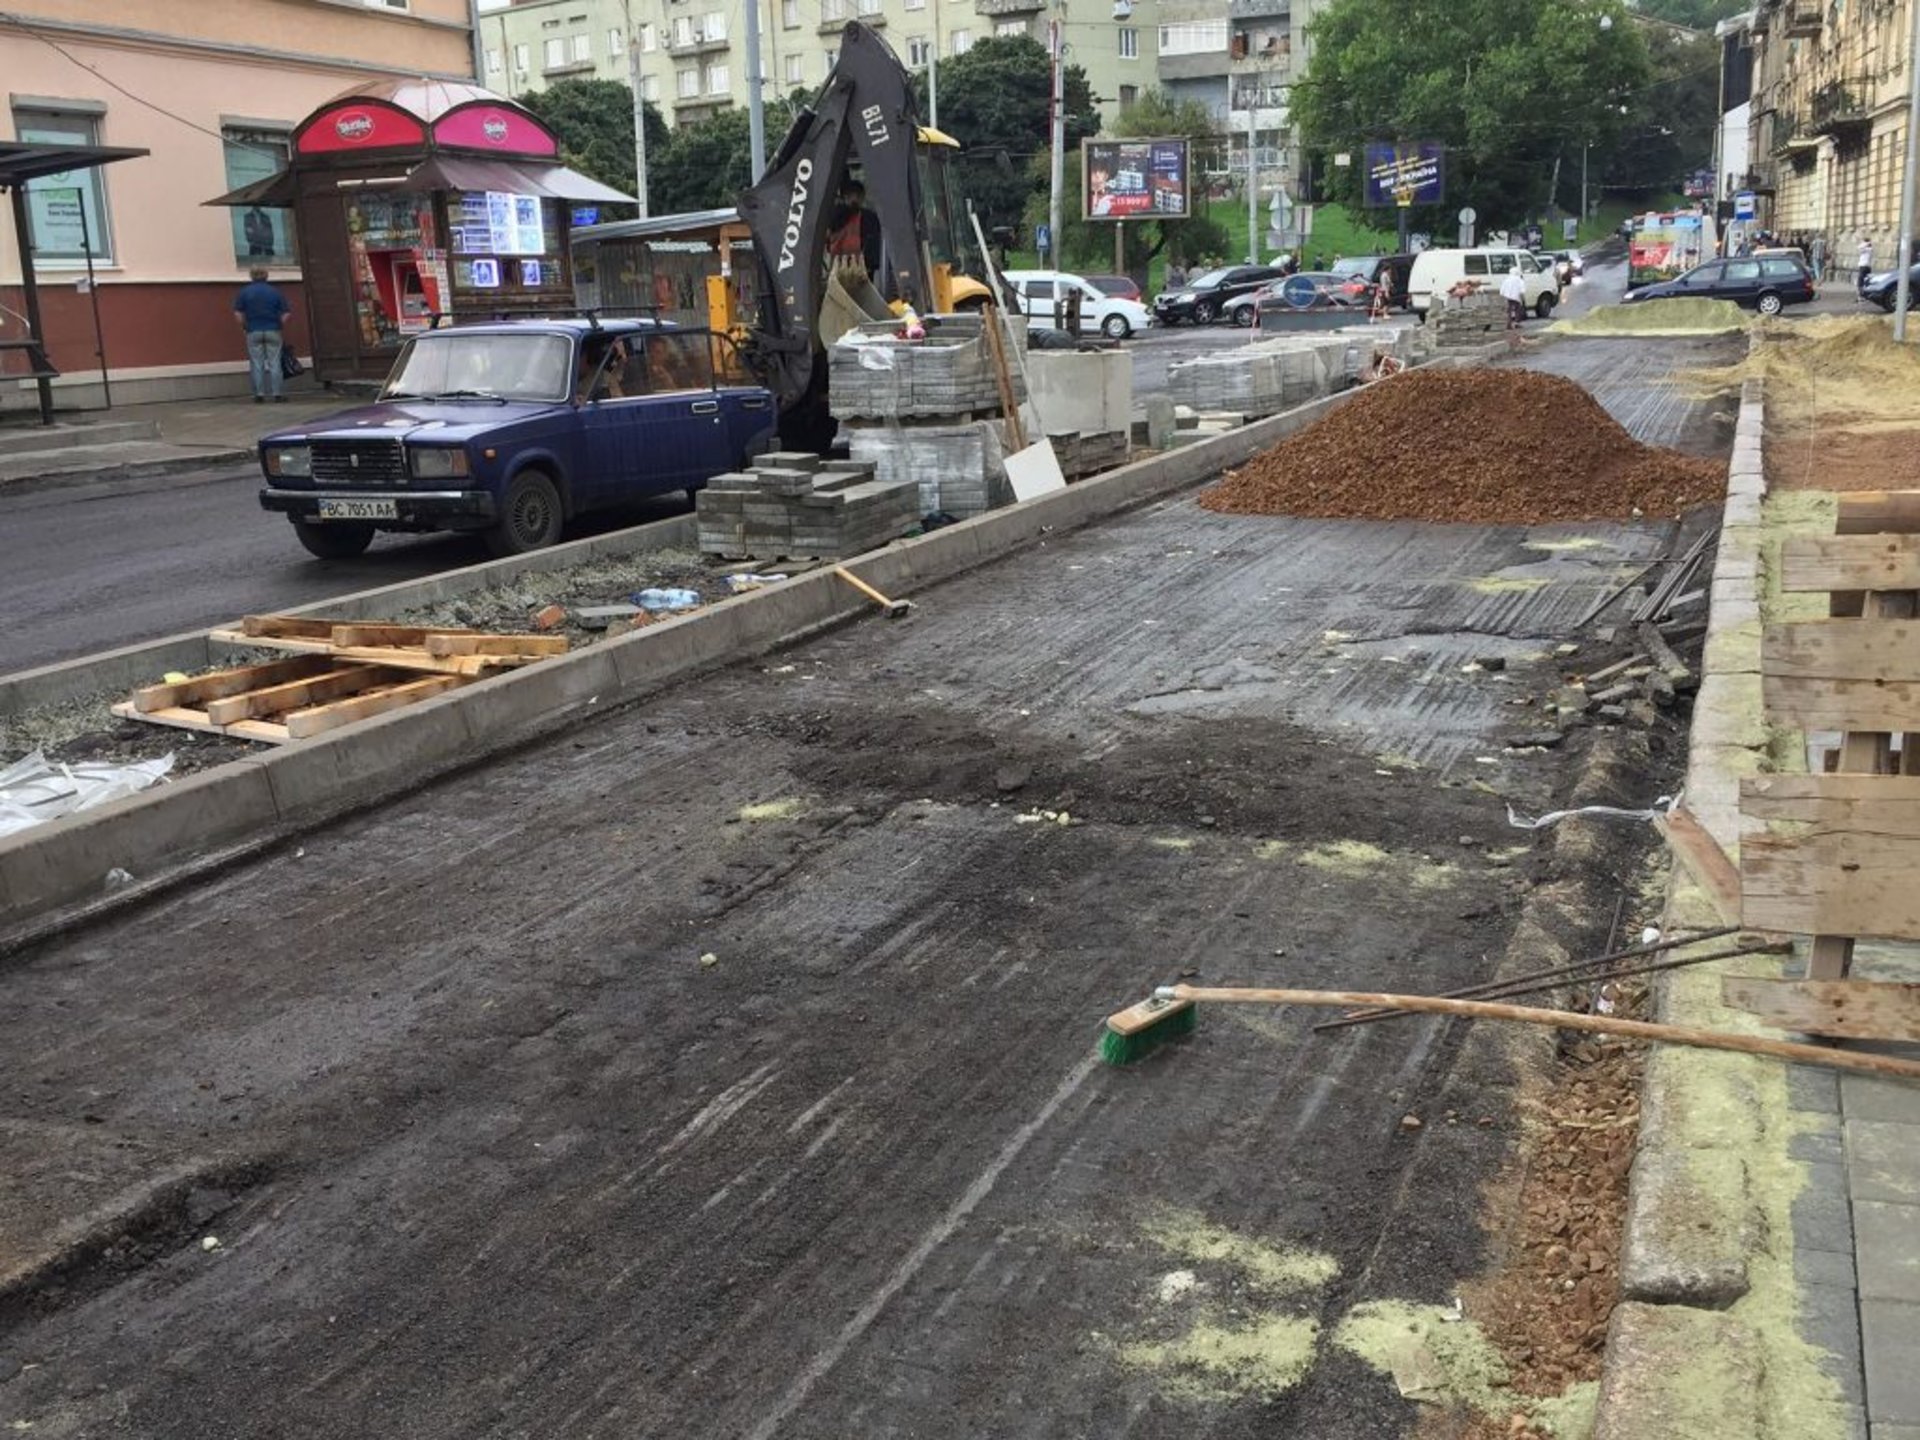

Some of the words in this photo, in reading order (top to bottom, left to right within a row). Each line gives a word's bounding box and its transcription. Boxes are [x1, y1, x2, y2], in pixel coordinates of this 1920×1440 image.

[862, 104, 890, 147] BL71
[778, 158, 812, 273] VOLVO
[346, 502, 374, 516] 7051
[376, 503, 396, 516] AA
